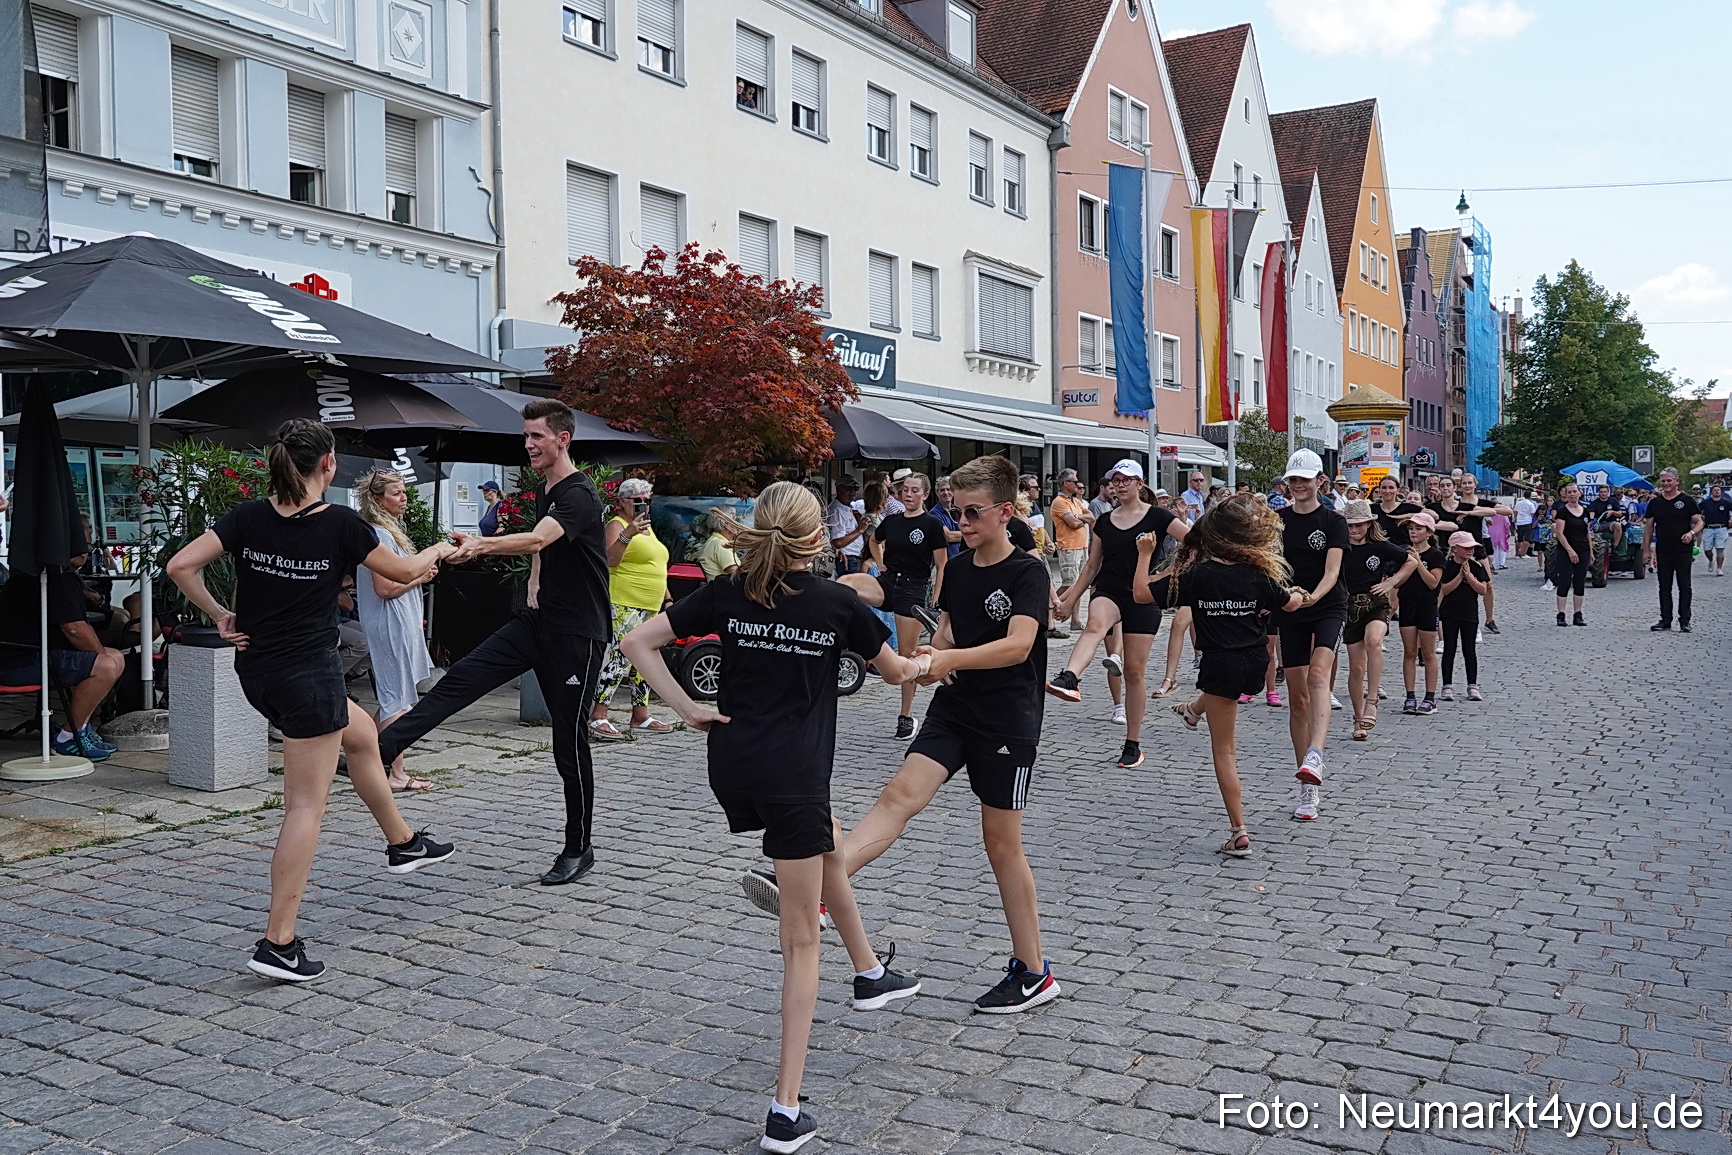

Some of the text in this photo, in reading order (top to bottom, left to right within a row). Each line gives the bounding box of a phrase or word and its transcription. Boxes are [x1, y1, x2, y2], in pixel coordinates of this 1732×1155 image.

[826, 332, 895, 381] ühauf
[315, 374, 356, 423] now
[1585, 475, 1598, 483] SV
[1579, 486, 1599, 496] STAU
[243, 547, 329, 570] FUNNY ROLLERS
[1198, 600, 1224, 609] FUNNY
[728, 618, 836, 646] FUNNY ROLLERS
[793, 645, 824, 657] Neumarkt
